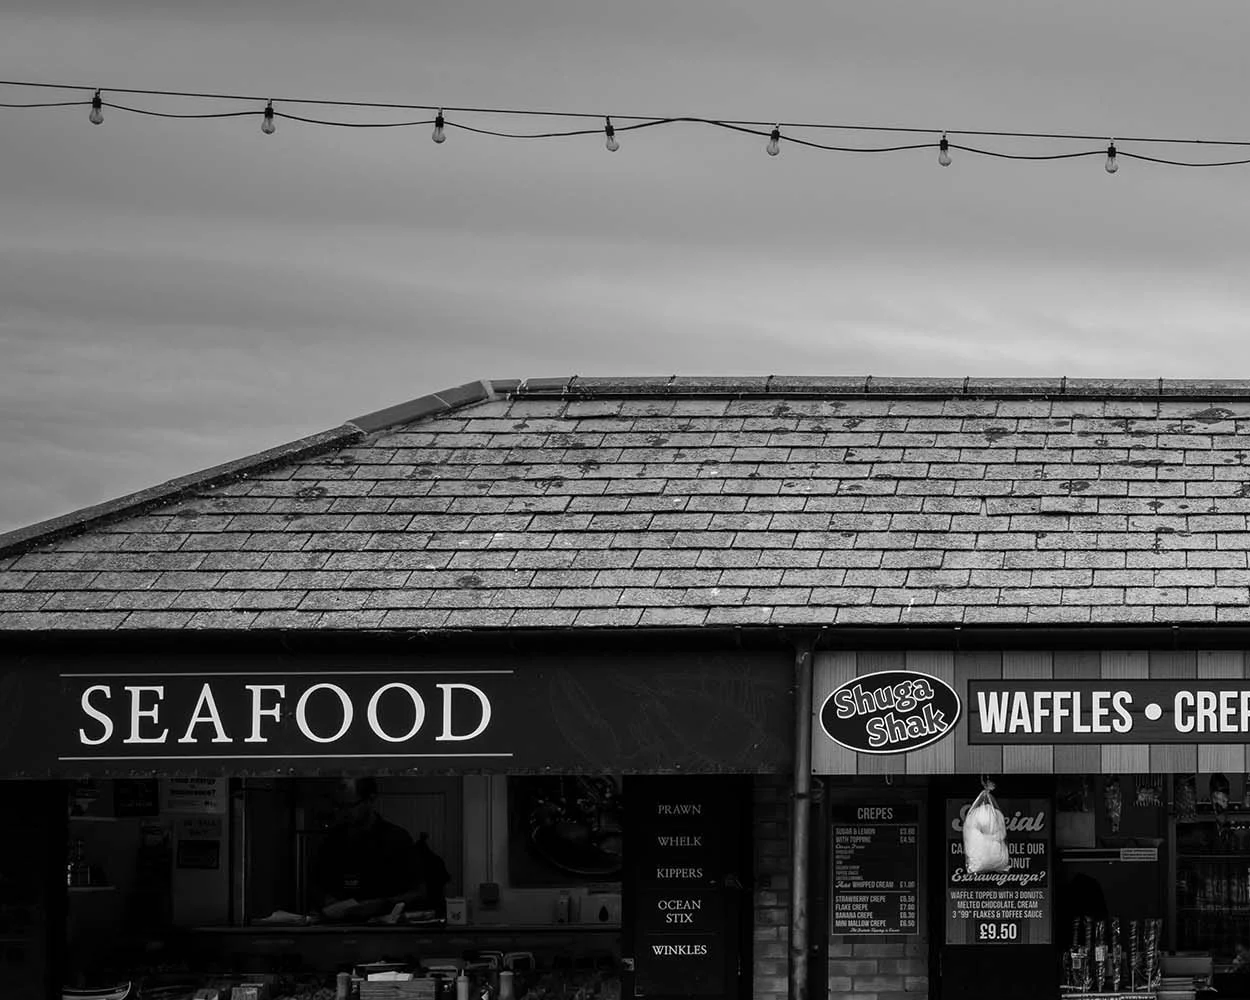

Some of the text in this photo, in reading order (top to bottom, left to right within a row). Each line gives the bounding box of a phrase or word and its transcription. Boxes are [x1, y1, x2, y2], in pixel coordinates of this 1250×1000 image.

[834, 678, 934, 719] Shuga
[78, 682, 493, 745] SEAFOOD
[977, 690, 1133, 733] WAFFLES
[866, 703, 948, 747] Shak
[658, 804, 702, 815] PRAWN
[857, 807, 894, 820] CREPES
[952, 804, 1045, 832] Scial
[658, 836, 702, 847] WHELK
[1027, 843, 1045, 855] OUR
[657, 868, 704, 879] KIPPERS
[951, 891, 974, 899] WAFFLE
[975, 891, 997, 899] TOPPED
[999, 891, 1014, 899] WITH
[1015, 891, 1019, 899] 3
[657, 899, 702, 911] OCEAN
[957, 901, 980, 909] MELTED
[1017, 901, 1038, 909] CREAM
[665, 913, 694, 924] STIX
[952, 910, 956, 919] 3
[973, 910, 995, 919] FLAKES
[1002, 910, 1023, 919] TOFFEE
[1024, 910, 1043, 919] SAUCE
[980, 923, 1017, 940] £9.50
[652, 945, 708, 956] WINKLES
